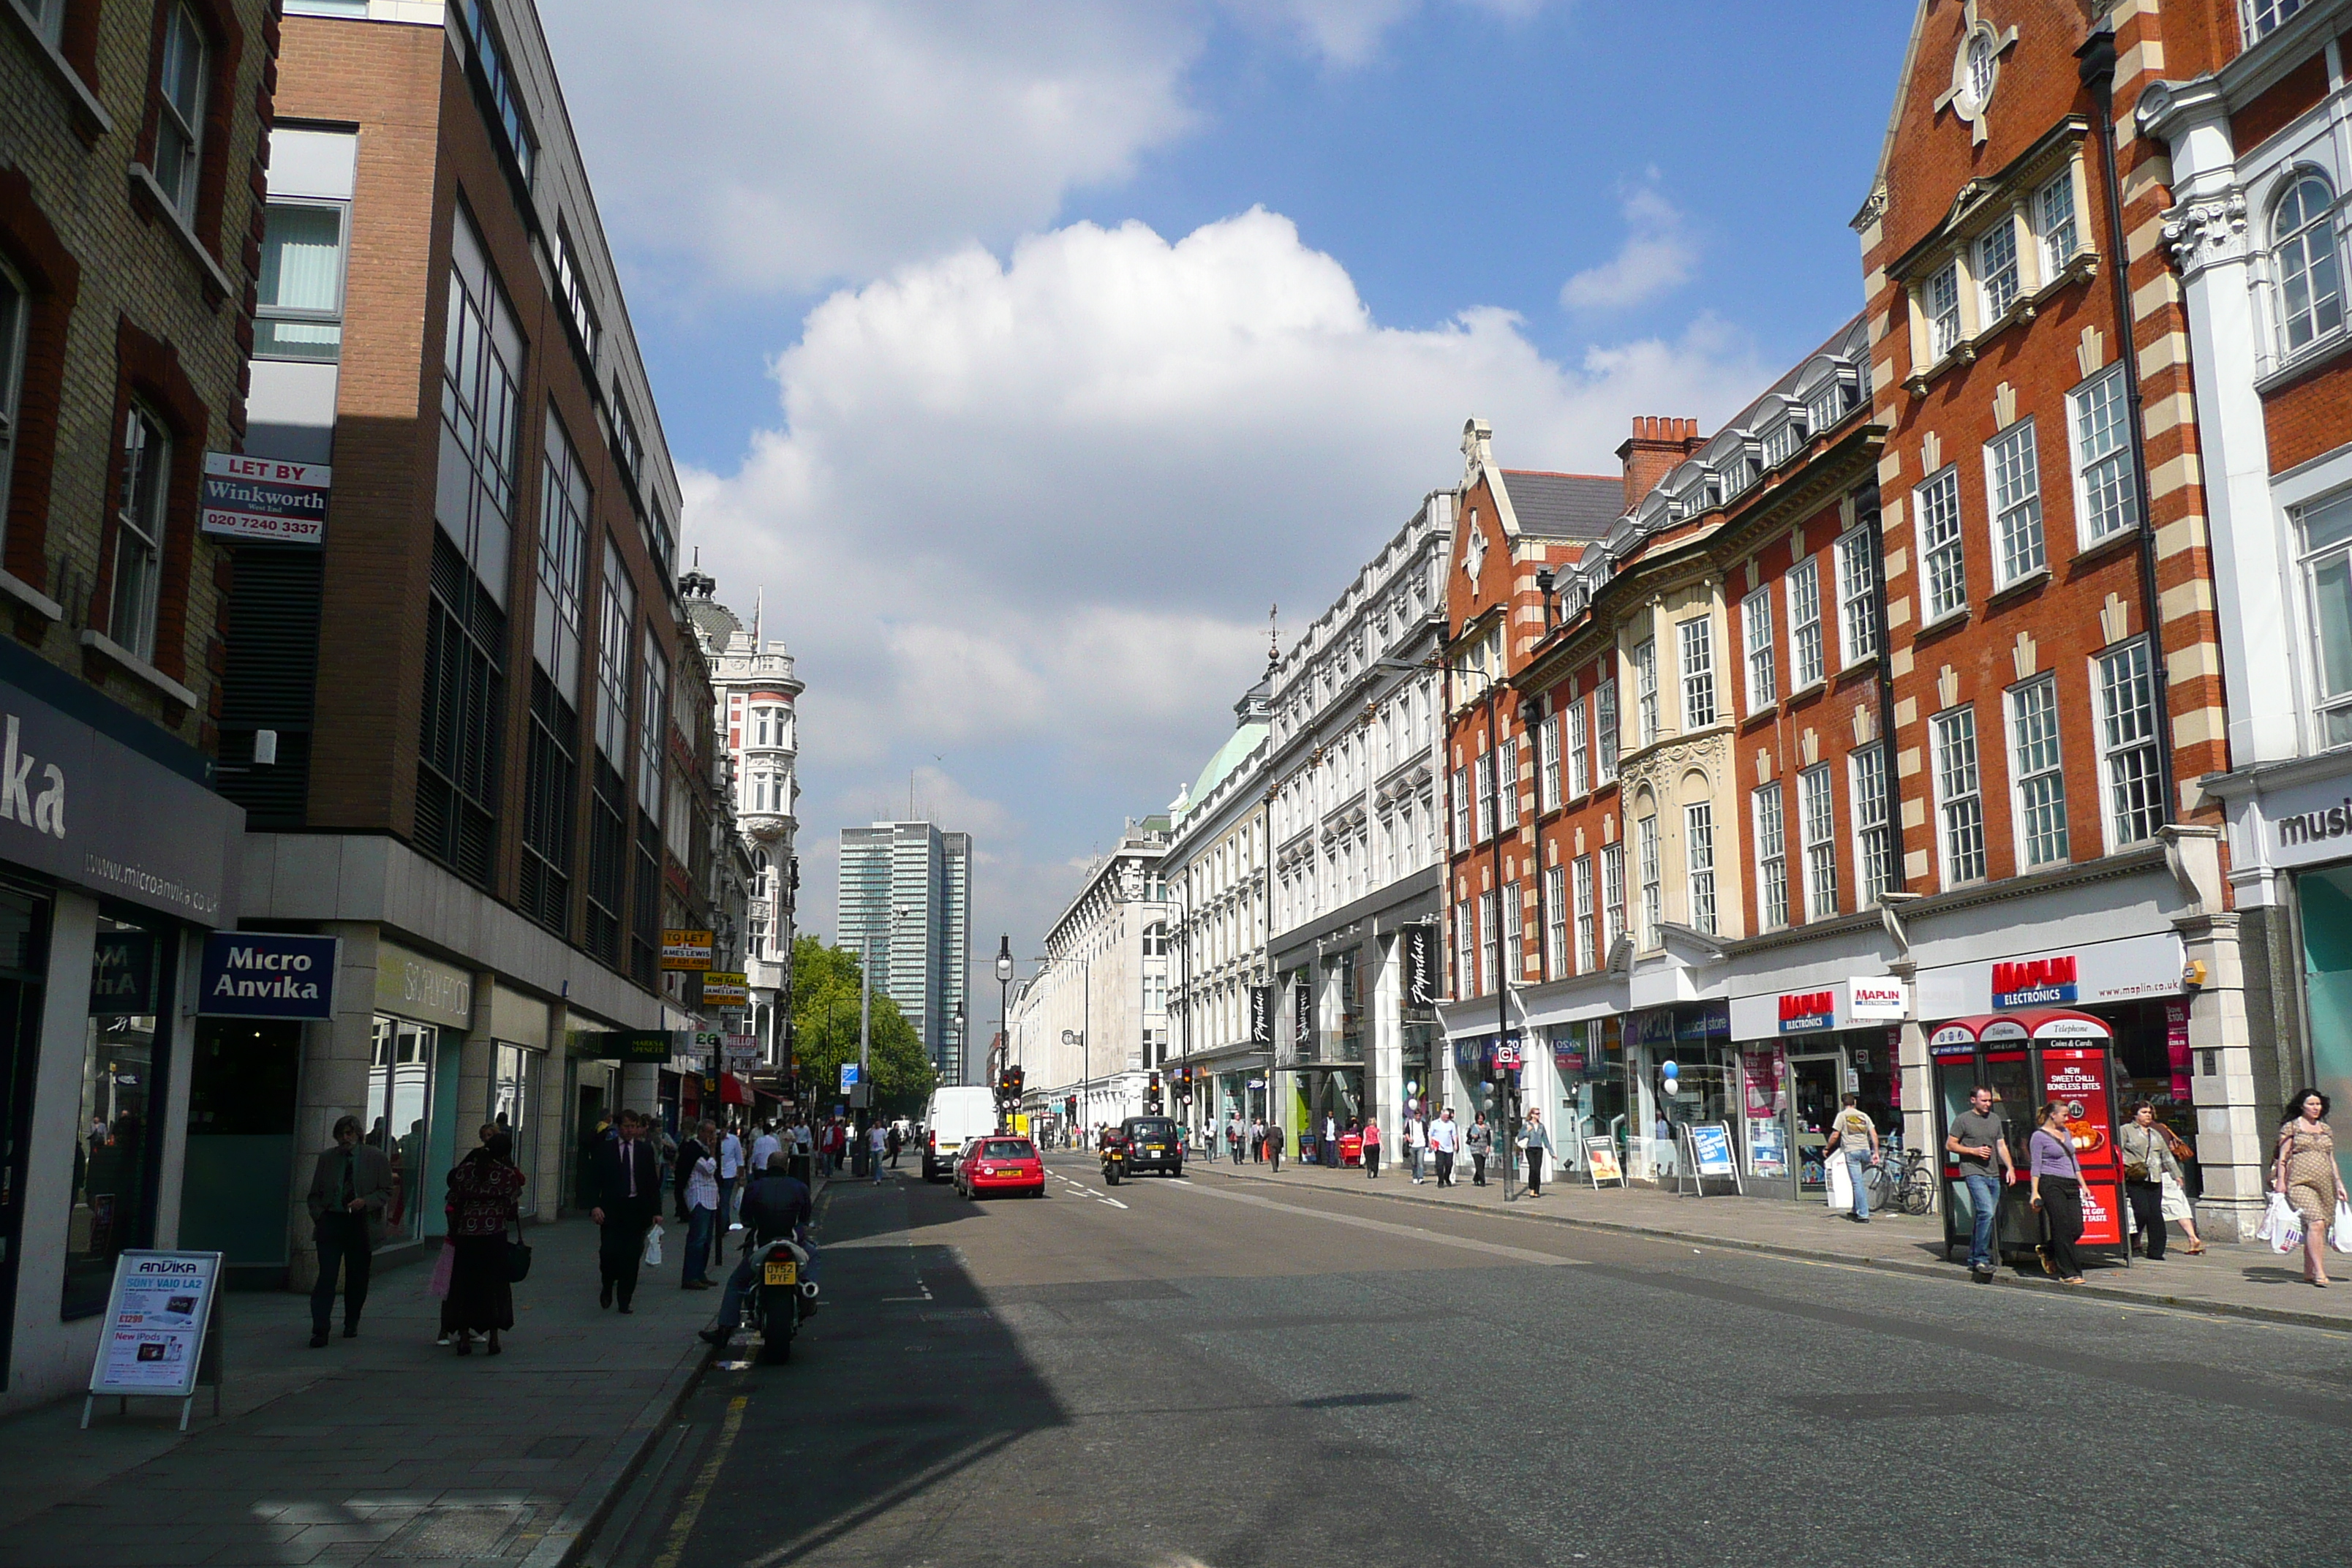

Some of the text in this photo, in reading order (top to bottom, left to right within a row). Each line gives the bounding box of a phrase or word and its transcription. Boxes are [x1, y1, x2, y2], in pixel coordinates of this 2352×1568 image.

[229, 459, 306, 480] LET BY
[207, 480, 324, 510] Winkworth
[248, 503, 265, 511] West
[208, 514, 236, 526] 020
[241, 518, 277, 530] 7240
[282, 521, 318, 535] 3337
[86, 853, 219, 913] www.microanvika.co.uk
[666, 933, 705, 942] TO LET
[226, 946, 313, 972] Micro
[1992, 956, 2076, 994] MAPLIN
[213, 973, 320, 1000] Anvika
[1856, 990, 1899, 1000] MAPLIN
[2098, 979, 2178, 996] www.maplin.co.uk
[1779, 992, 1834, 1020] MAPLIN
[2005, 989, 2061, 1006] ELECTRONICS
[1708, 1017, 1727, 1030] store
[1786, 1017, 1823, 1030] ELECTRONICS
[2054, 1025, 2088, 1034] Telephone
[127, 1278, 154, 1288] SONY
[157, 1278, 180, 1288] VAIO
[116, 1333, 161, 1341] New iPods
